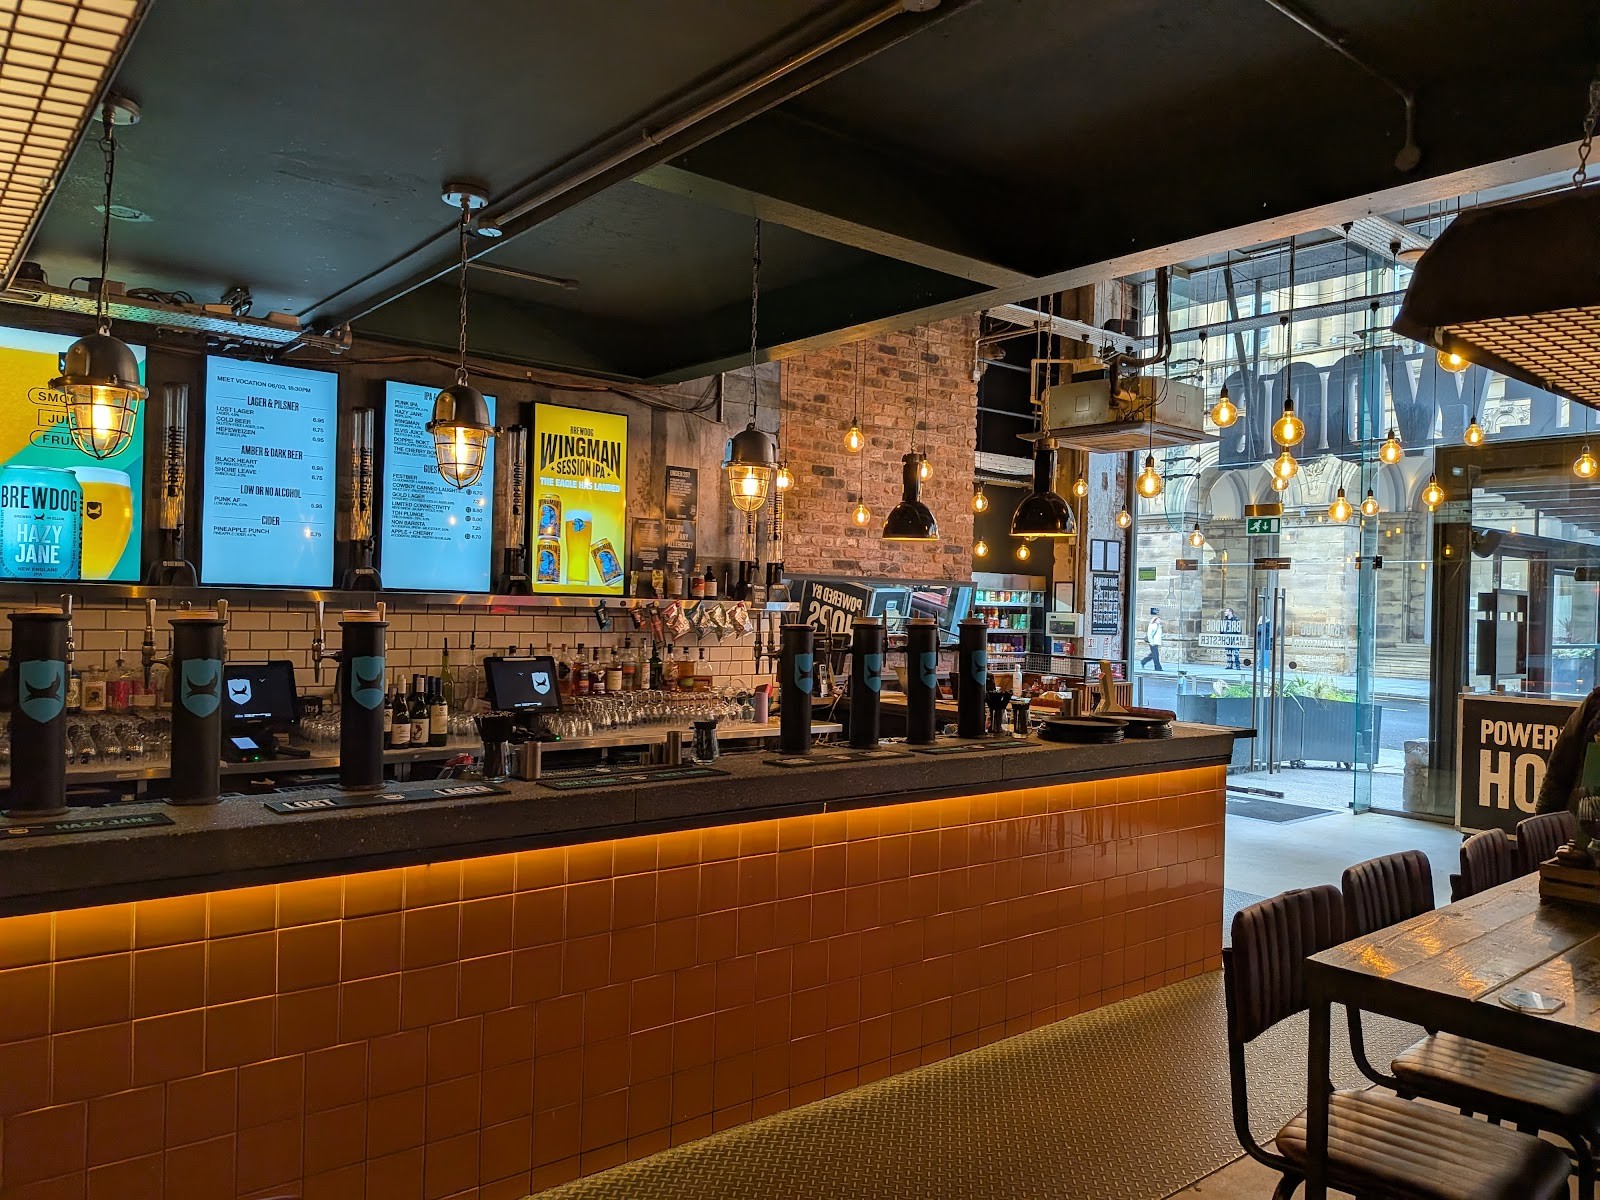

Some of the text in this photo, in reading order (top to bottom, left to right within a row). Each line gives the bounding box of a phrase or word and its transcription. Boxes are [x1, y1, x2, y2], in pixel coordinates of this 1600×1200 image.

[217, 375, 234, 383] MEET
[235, 378, 267, 388] VOCATION
[216, 405, 255, 415] LOST LAGER
[247, 395, 300, 412] LAGER & PILSNER
[215, 415, 252, 425] COLD BEER
[570, 425, 594, 437] BREWDOG
[241, 445, 303, 460] AMBER & DARK BEER
[540, 432, 621, 480] WINGMAN
[237, 457, 258, 465] HEART
[556, 458, 606, 479] SESSION IPA
[238, 467, 257, 475] LEAVE
[240, 484, 302, 499] LOW OR NO ALCOHOL
[539, 476, 621, 493] THE EAGLE HAS LANDED
[1, 485, 77, 513] BREWDOG
[413, 502, 451, 511] CONNECTIVITY
[261, 515, 280, 526] CIDER
[17, 523, 63, 544] HAZY
[213, 525, 248, 533] PINEAPPLE
[14, 543, 61, 564] JANE
[1480, 719, 1565, 750] POWER
[1479, 749, 1547, 814] HO
[55, 816, 156, 830] HAZY JANE
